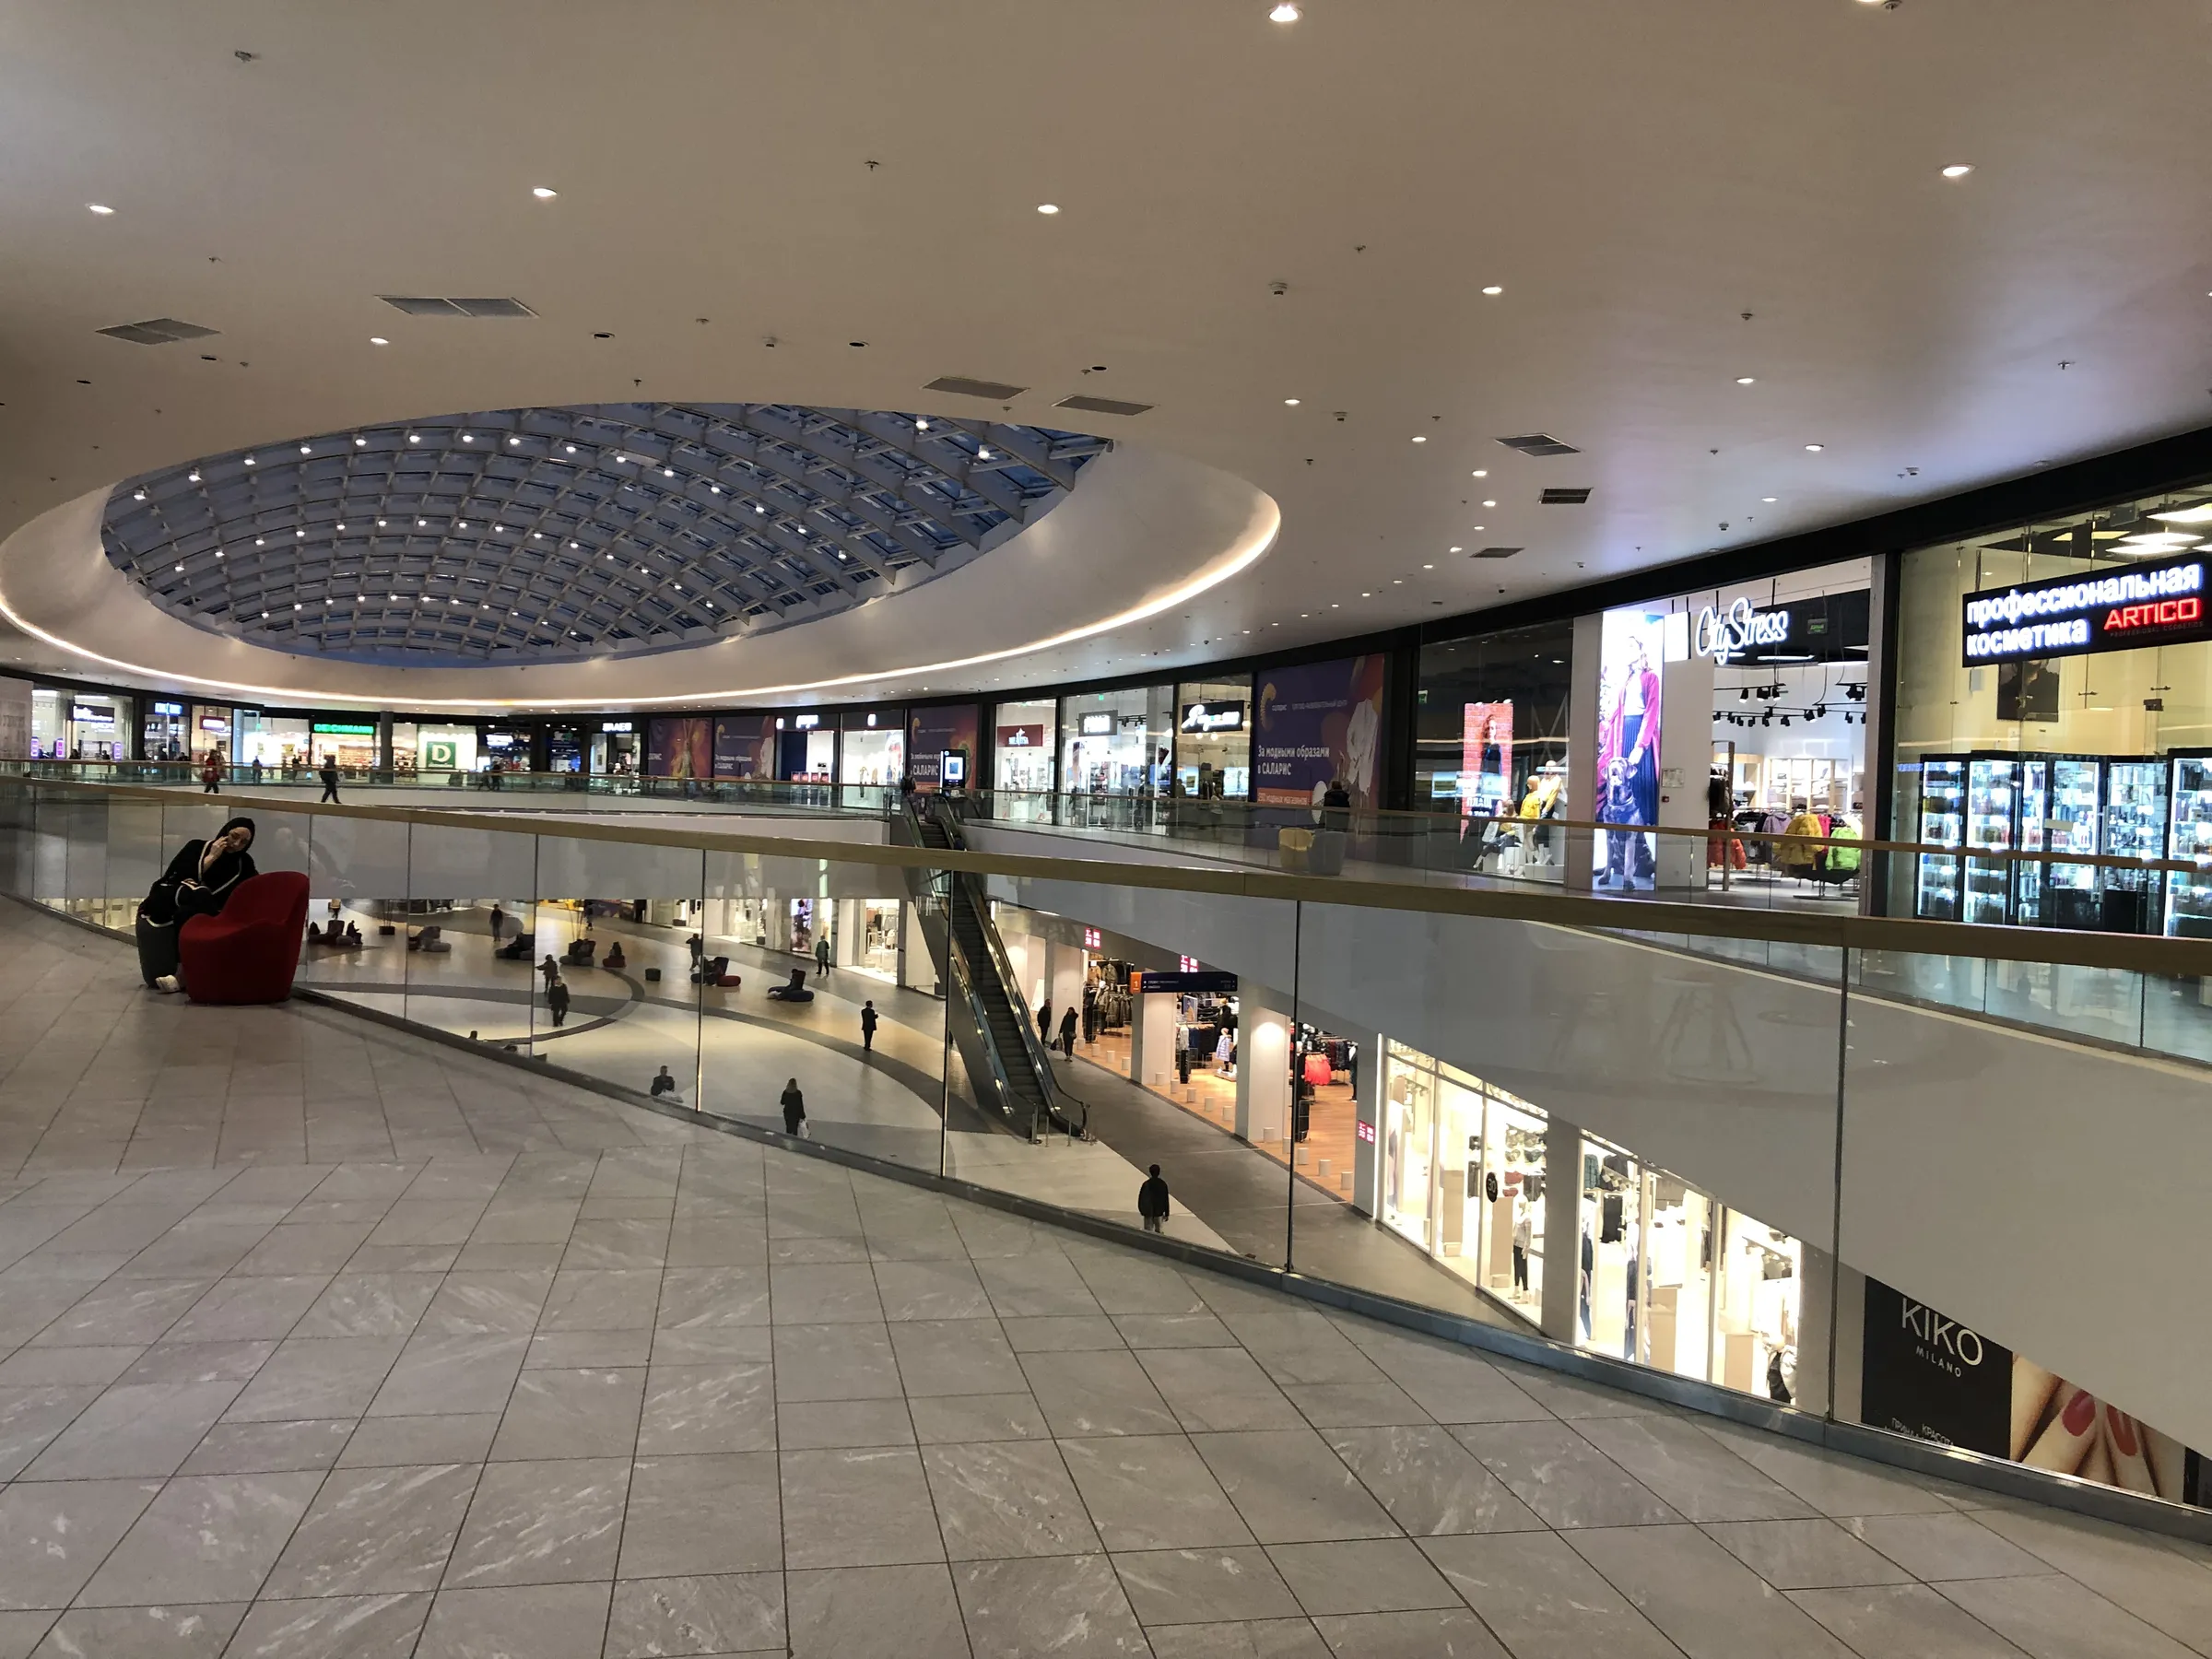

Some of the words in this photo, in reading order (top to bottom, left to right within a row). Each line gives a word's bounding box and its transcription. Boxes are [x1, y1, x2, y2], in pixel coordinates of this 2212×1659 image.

[1966, 563, 2201, 628] профессиональная
[2103, 597, 2199, 630] ARTICO
[1966, 618, 2088, 655] косметика
[1266, 746, 1296, 759] модными
[1297, 745, 1330, 760] образами
[913, 764, 939, 776] САЛАРИС
[1263, 762, 1292, 776] САЛАРИС
[1901, 1297, 1983, 1366] KIKO
[1915, 1346, 1961, 1377] MILANO
